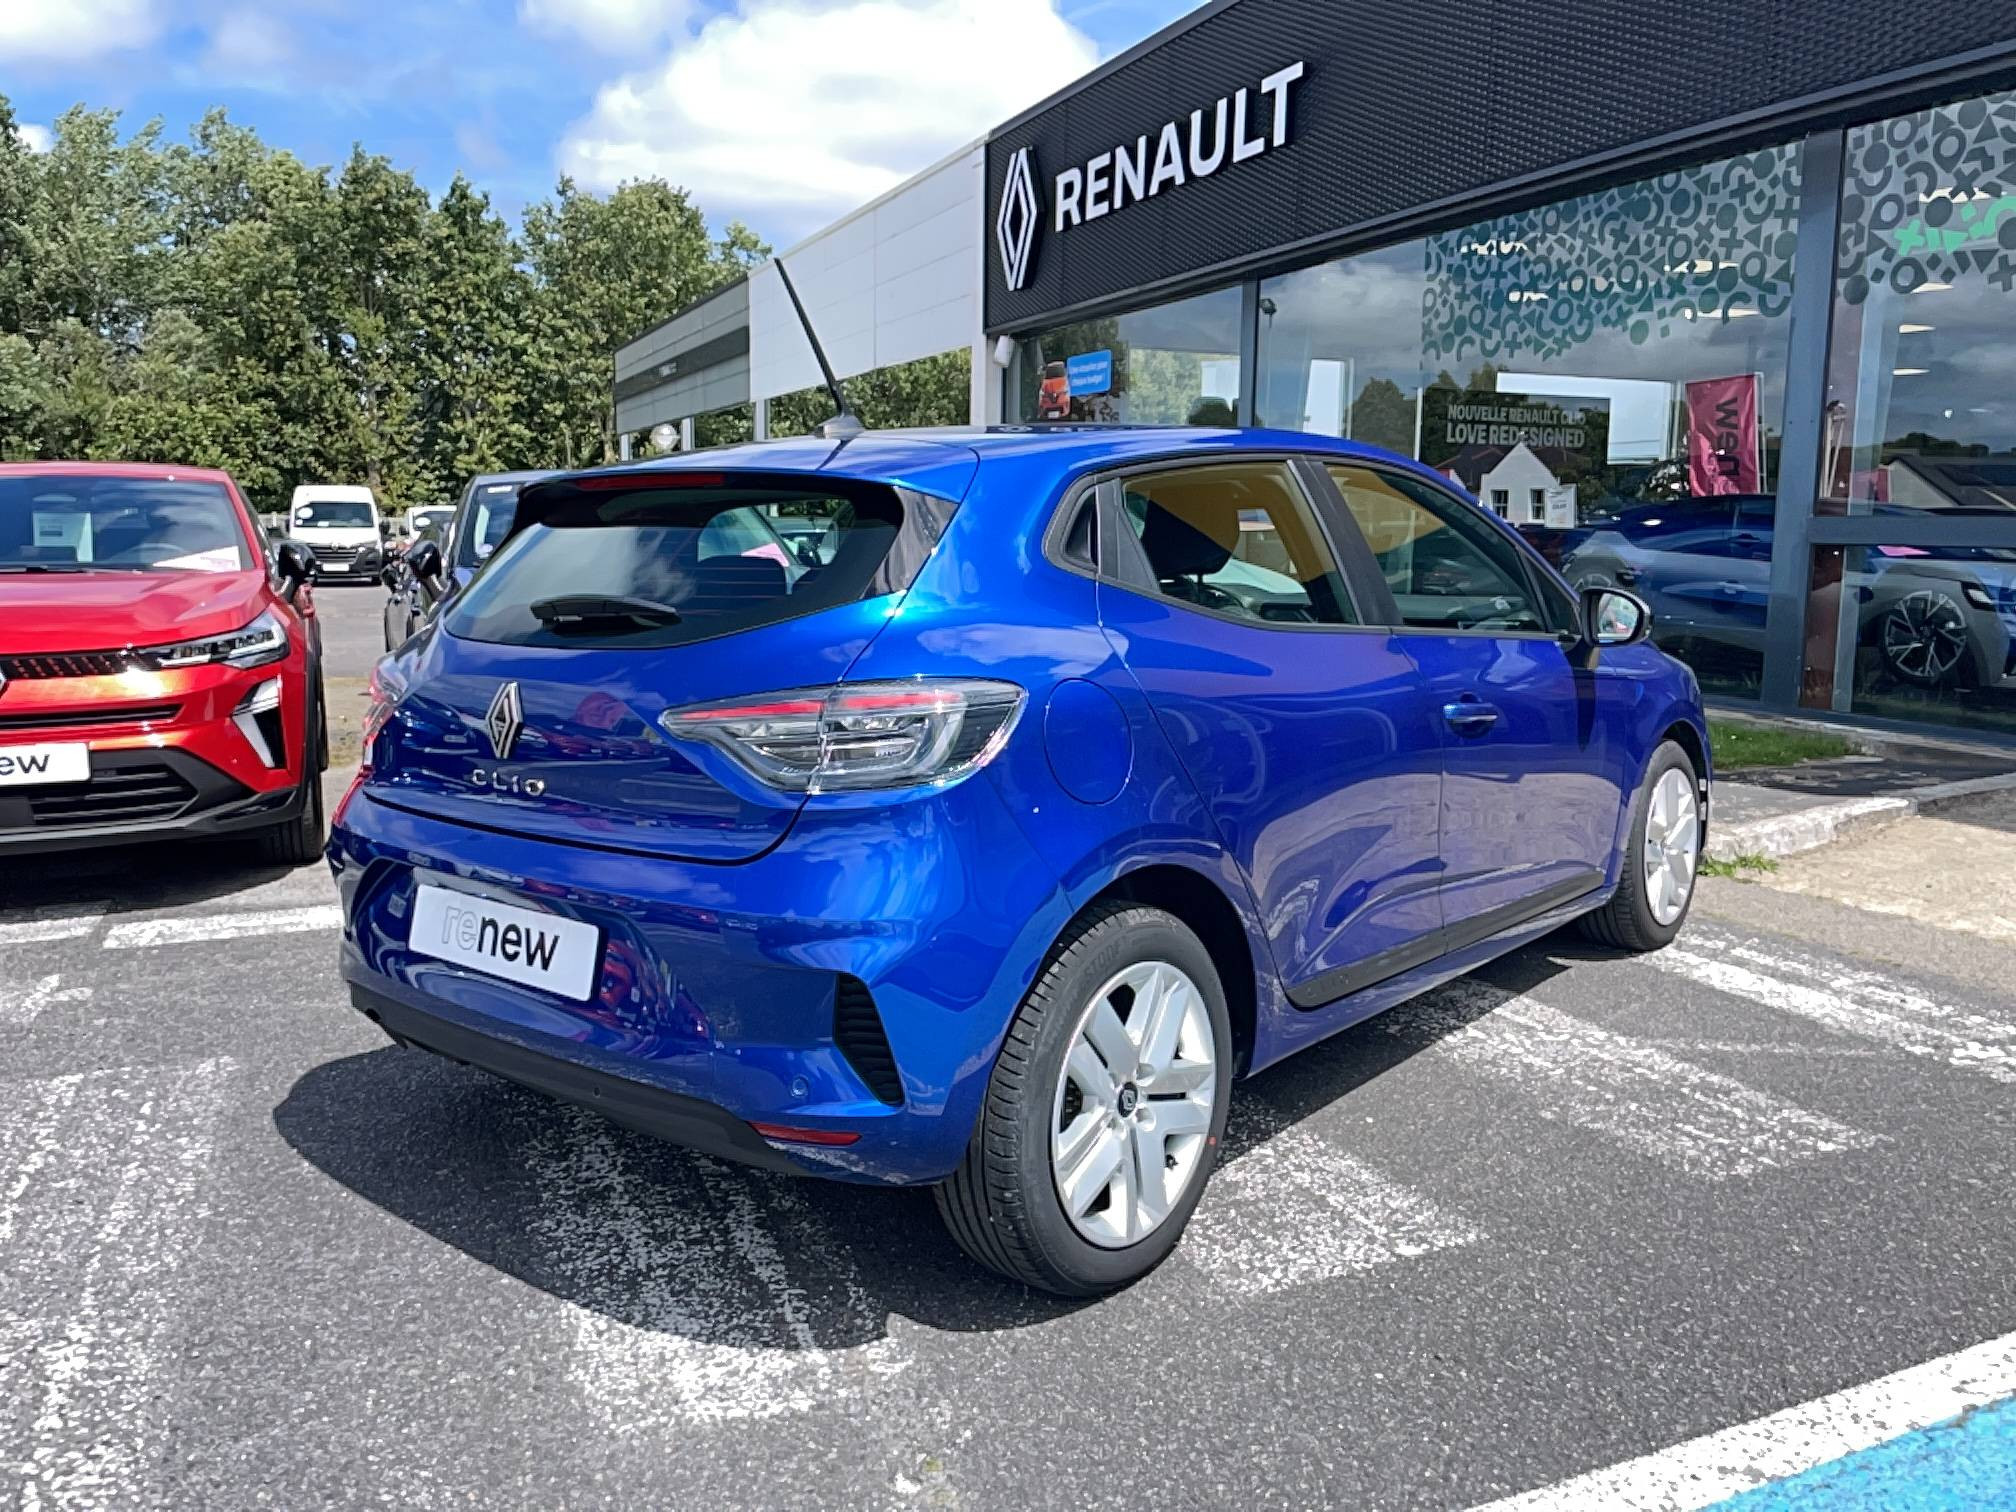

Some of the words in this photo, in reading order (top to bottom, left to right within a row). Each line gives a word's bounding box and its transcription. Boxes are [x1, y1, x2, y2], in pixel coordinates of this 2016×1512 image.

[1055, 61, 1303, 232] RENAULT
[1448, 405, 1507, 422] NOUVELLE
[1508, 408, 1559, 424] RENAULT
[1560, 410, 1586, 425] CLIO
[1446, 422, 1487, 445] LOVE
[1489, 424, 1585, 448] REDESIGNED
[472, 769, 545, 796] CLIO
[441, 906, 560, 972] renew
